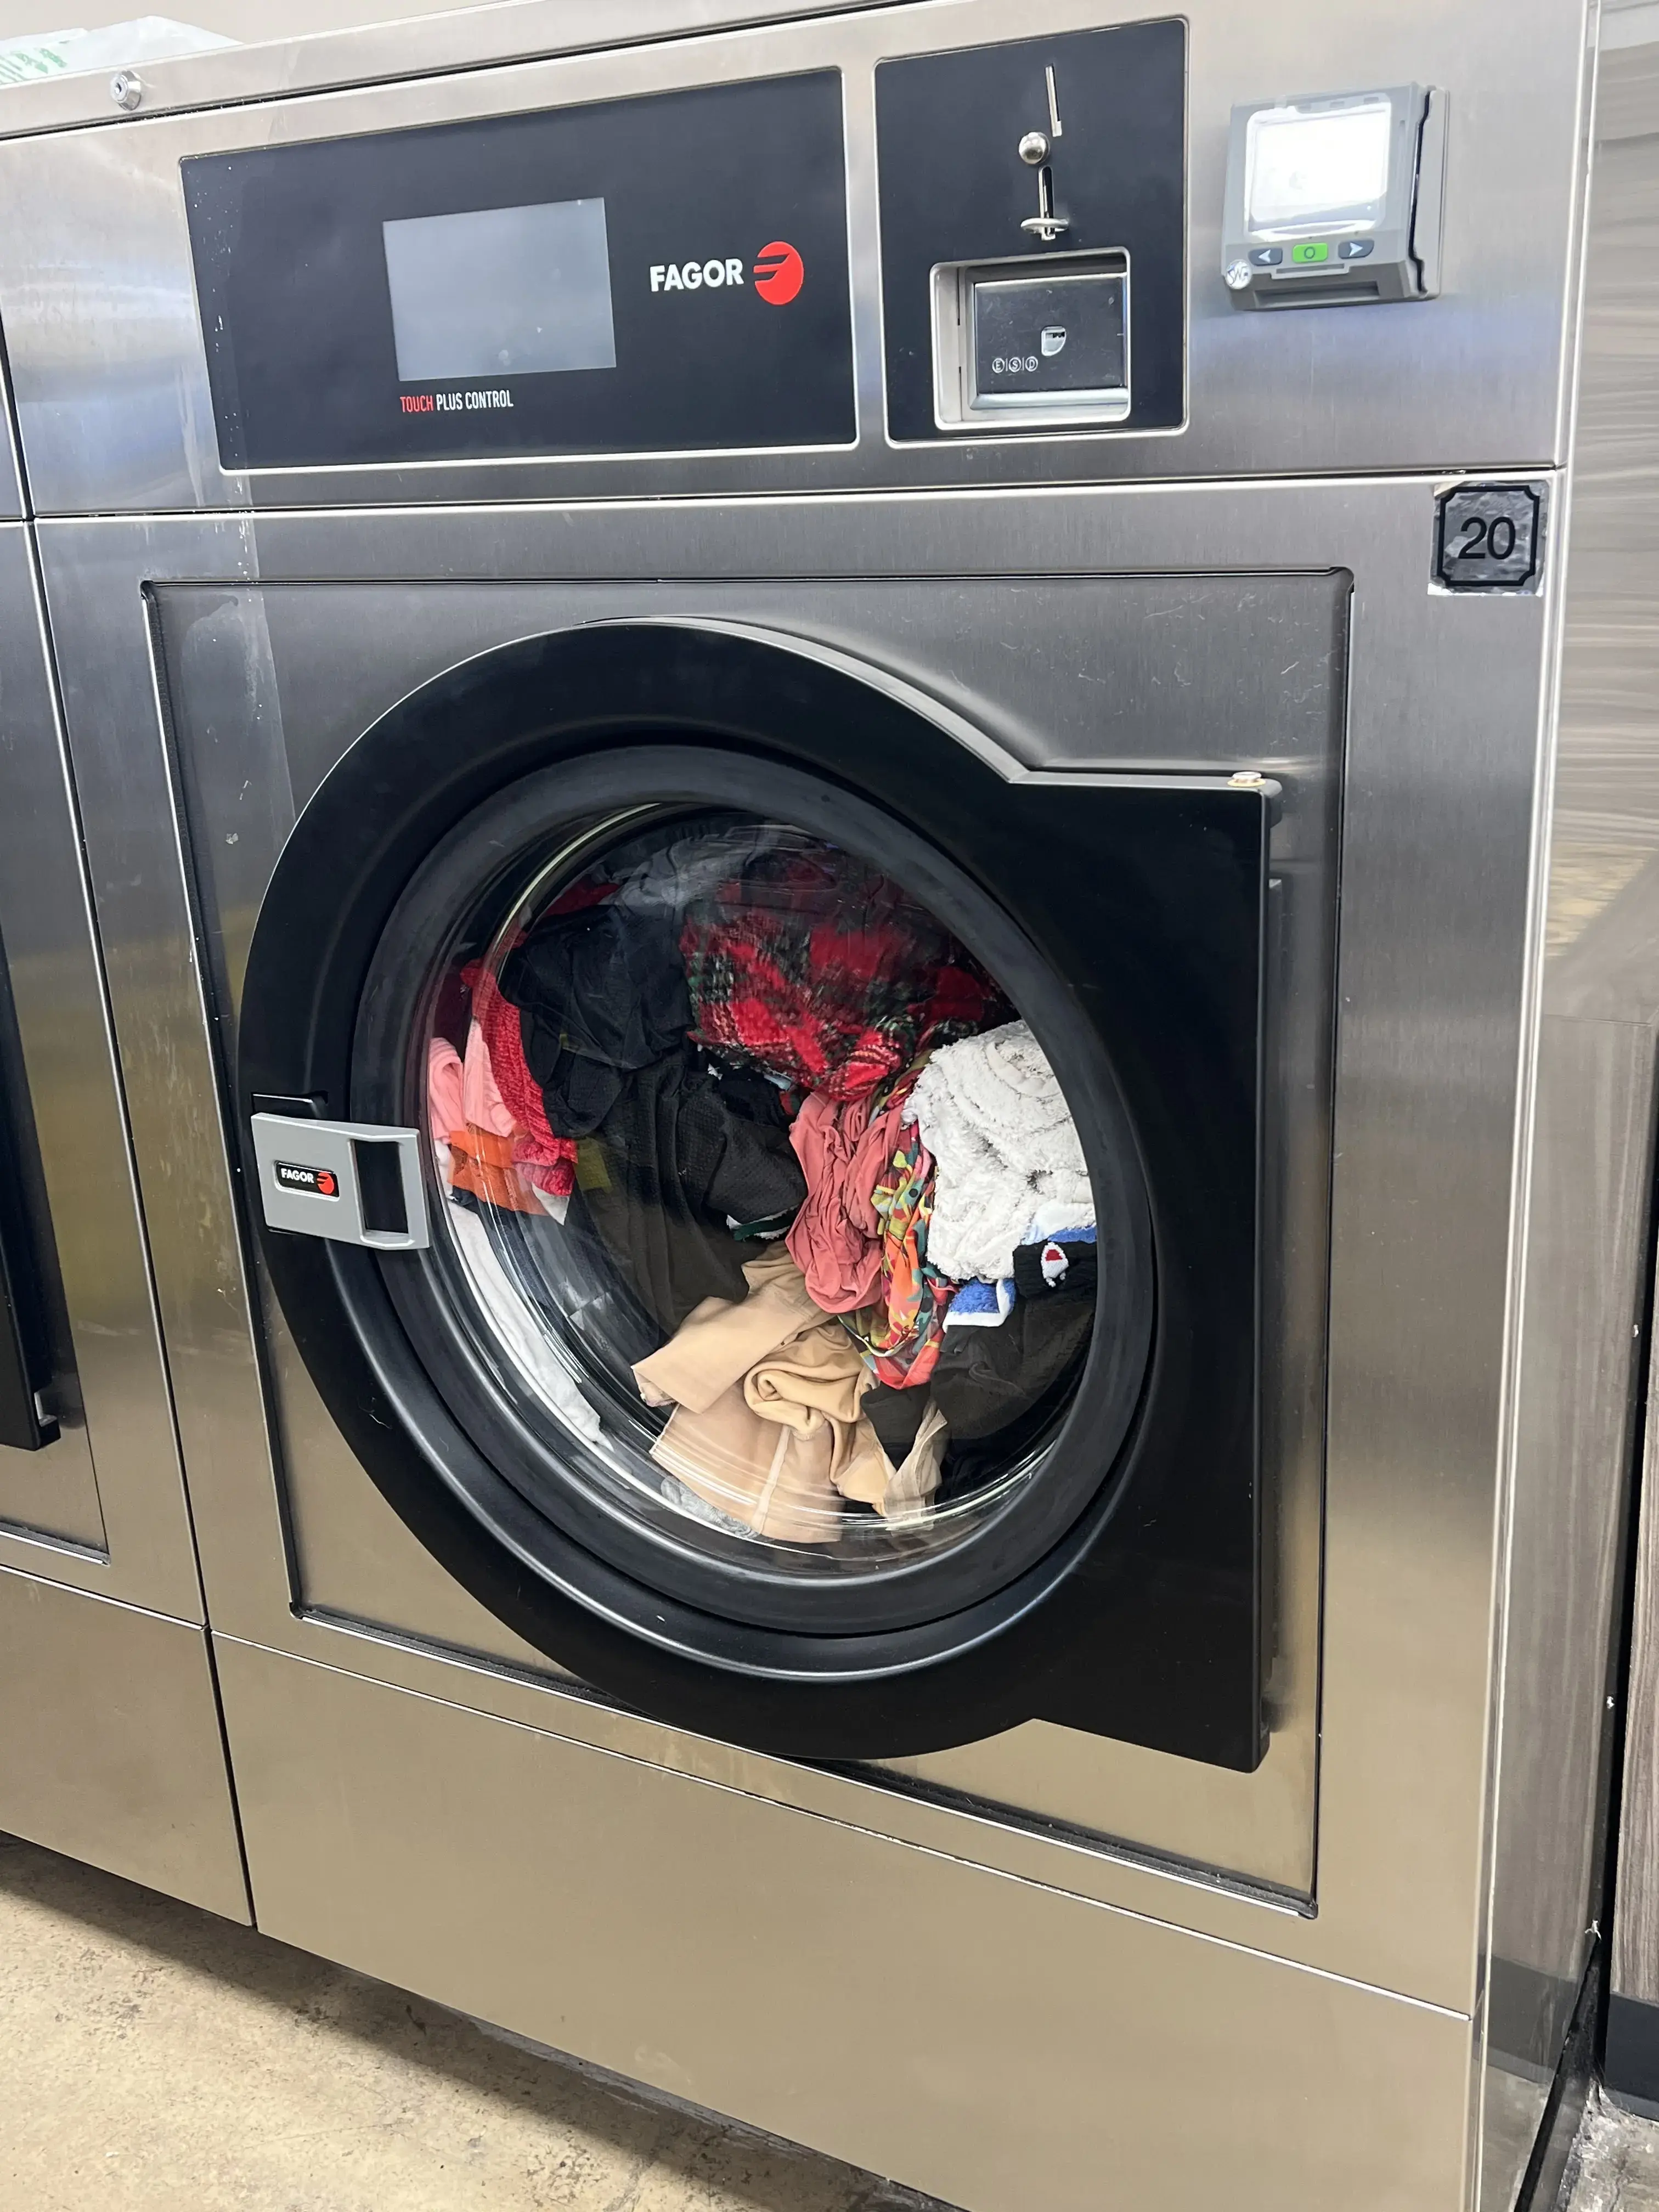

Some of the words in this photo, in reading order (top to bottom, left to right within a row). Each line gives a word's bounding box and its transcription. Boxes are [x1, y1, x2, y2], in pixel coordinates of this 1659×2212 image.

[650, 258, 744, 292] FAGOR
[400, 395, 434, 413] TOUCH
[436, 392, 463, 411] PLUS
[465, 390, 514, 409] CONTROL
[1458, 516, 1516, 560] 20
[280, 1168, 314, 1183] FAGOR
